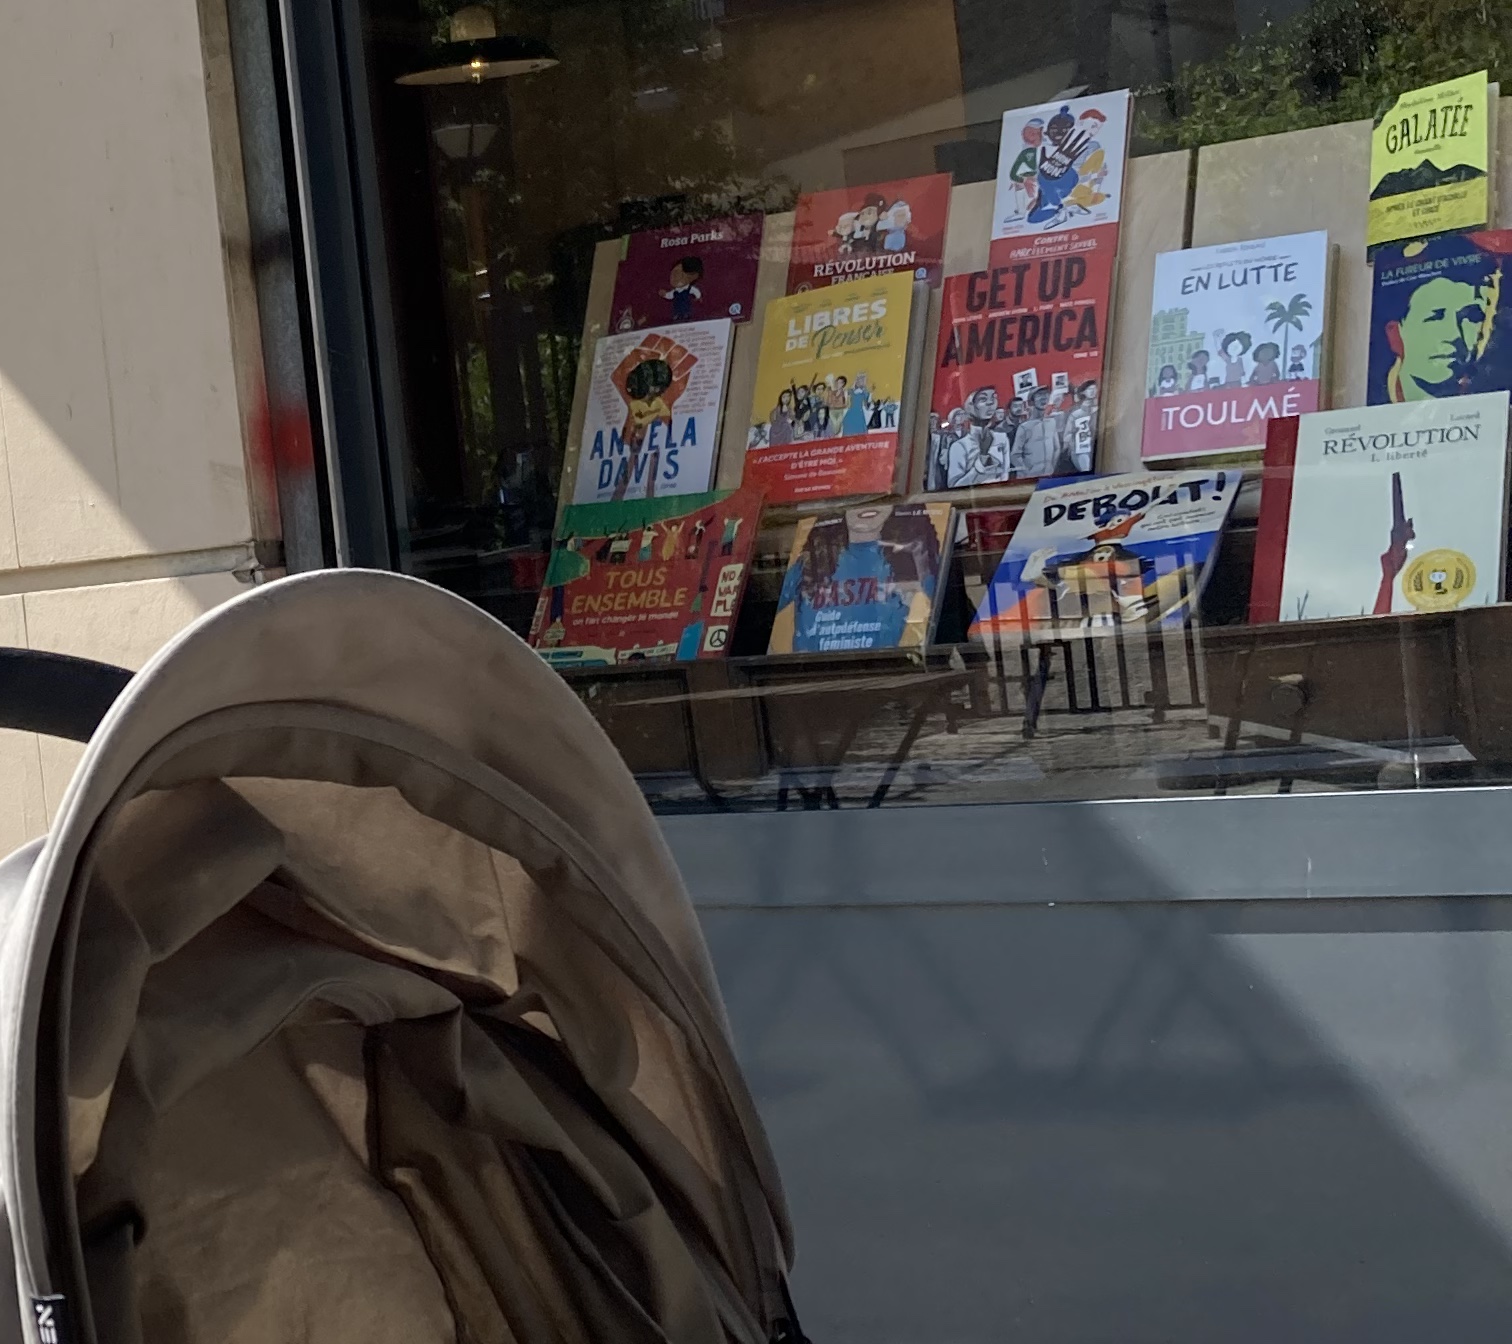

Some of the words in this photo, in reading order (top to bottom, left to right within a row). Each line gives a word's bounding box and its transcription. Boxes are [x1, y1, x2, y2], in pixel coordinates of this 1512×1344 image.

[1385, 97, 1474, 154] GALATÉE
[660, 236, 688, 249] Rosa
[690, 229, 724, 244] Parks
[813, 251, 917, 277] RÉVOLUTION
[1181, 272, 1211, 295] EN
[1218, 262, 1298, 291] LUTTE
[966, 262, 1031, 313] GET
[1039, 256, 1086, 303] UP
[789, 299, 887, 337] LIBRES
[785, 335, 809, 352] DE
[941, 307, 1098, 368] AMERICA
[1162, 387, 1301, 431] TOULMÉ
[590, 416, 697, 460] ANELA
[1323, 424, 1482, 455] RÉVOLUTION
[1387, 449, 1428, 460] liberté
[598, 450, 679, 489] DAVIS
[606, 566, 668, 589] TOUS
[571, 587, 688, 615] ENSEMBLE
[806, 621, 881, 637] d'autodéfense
[815, 611, 841, 622] Guide
[819, 635, 873, 651] féministe
